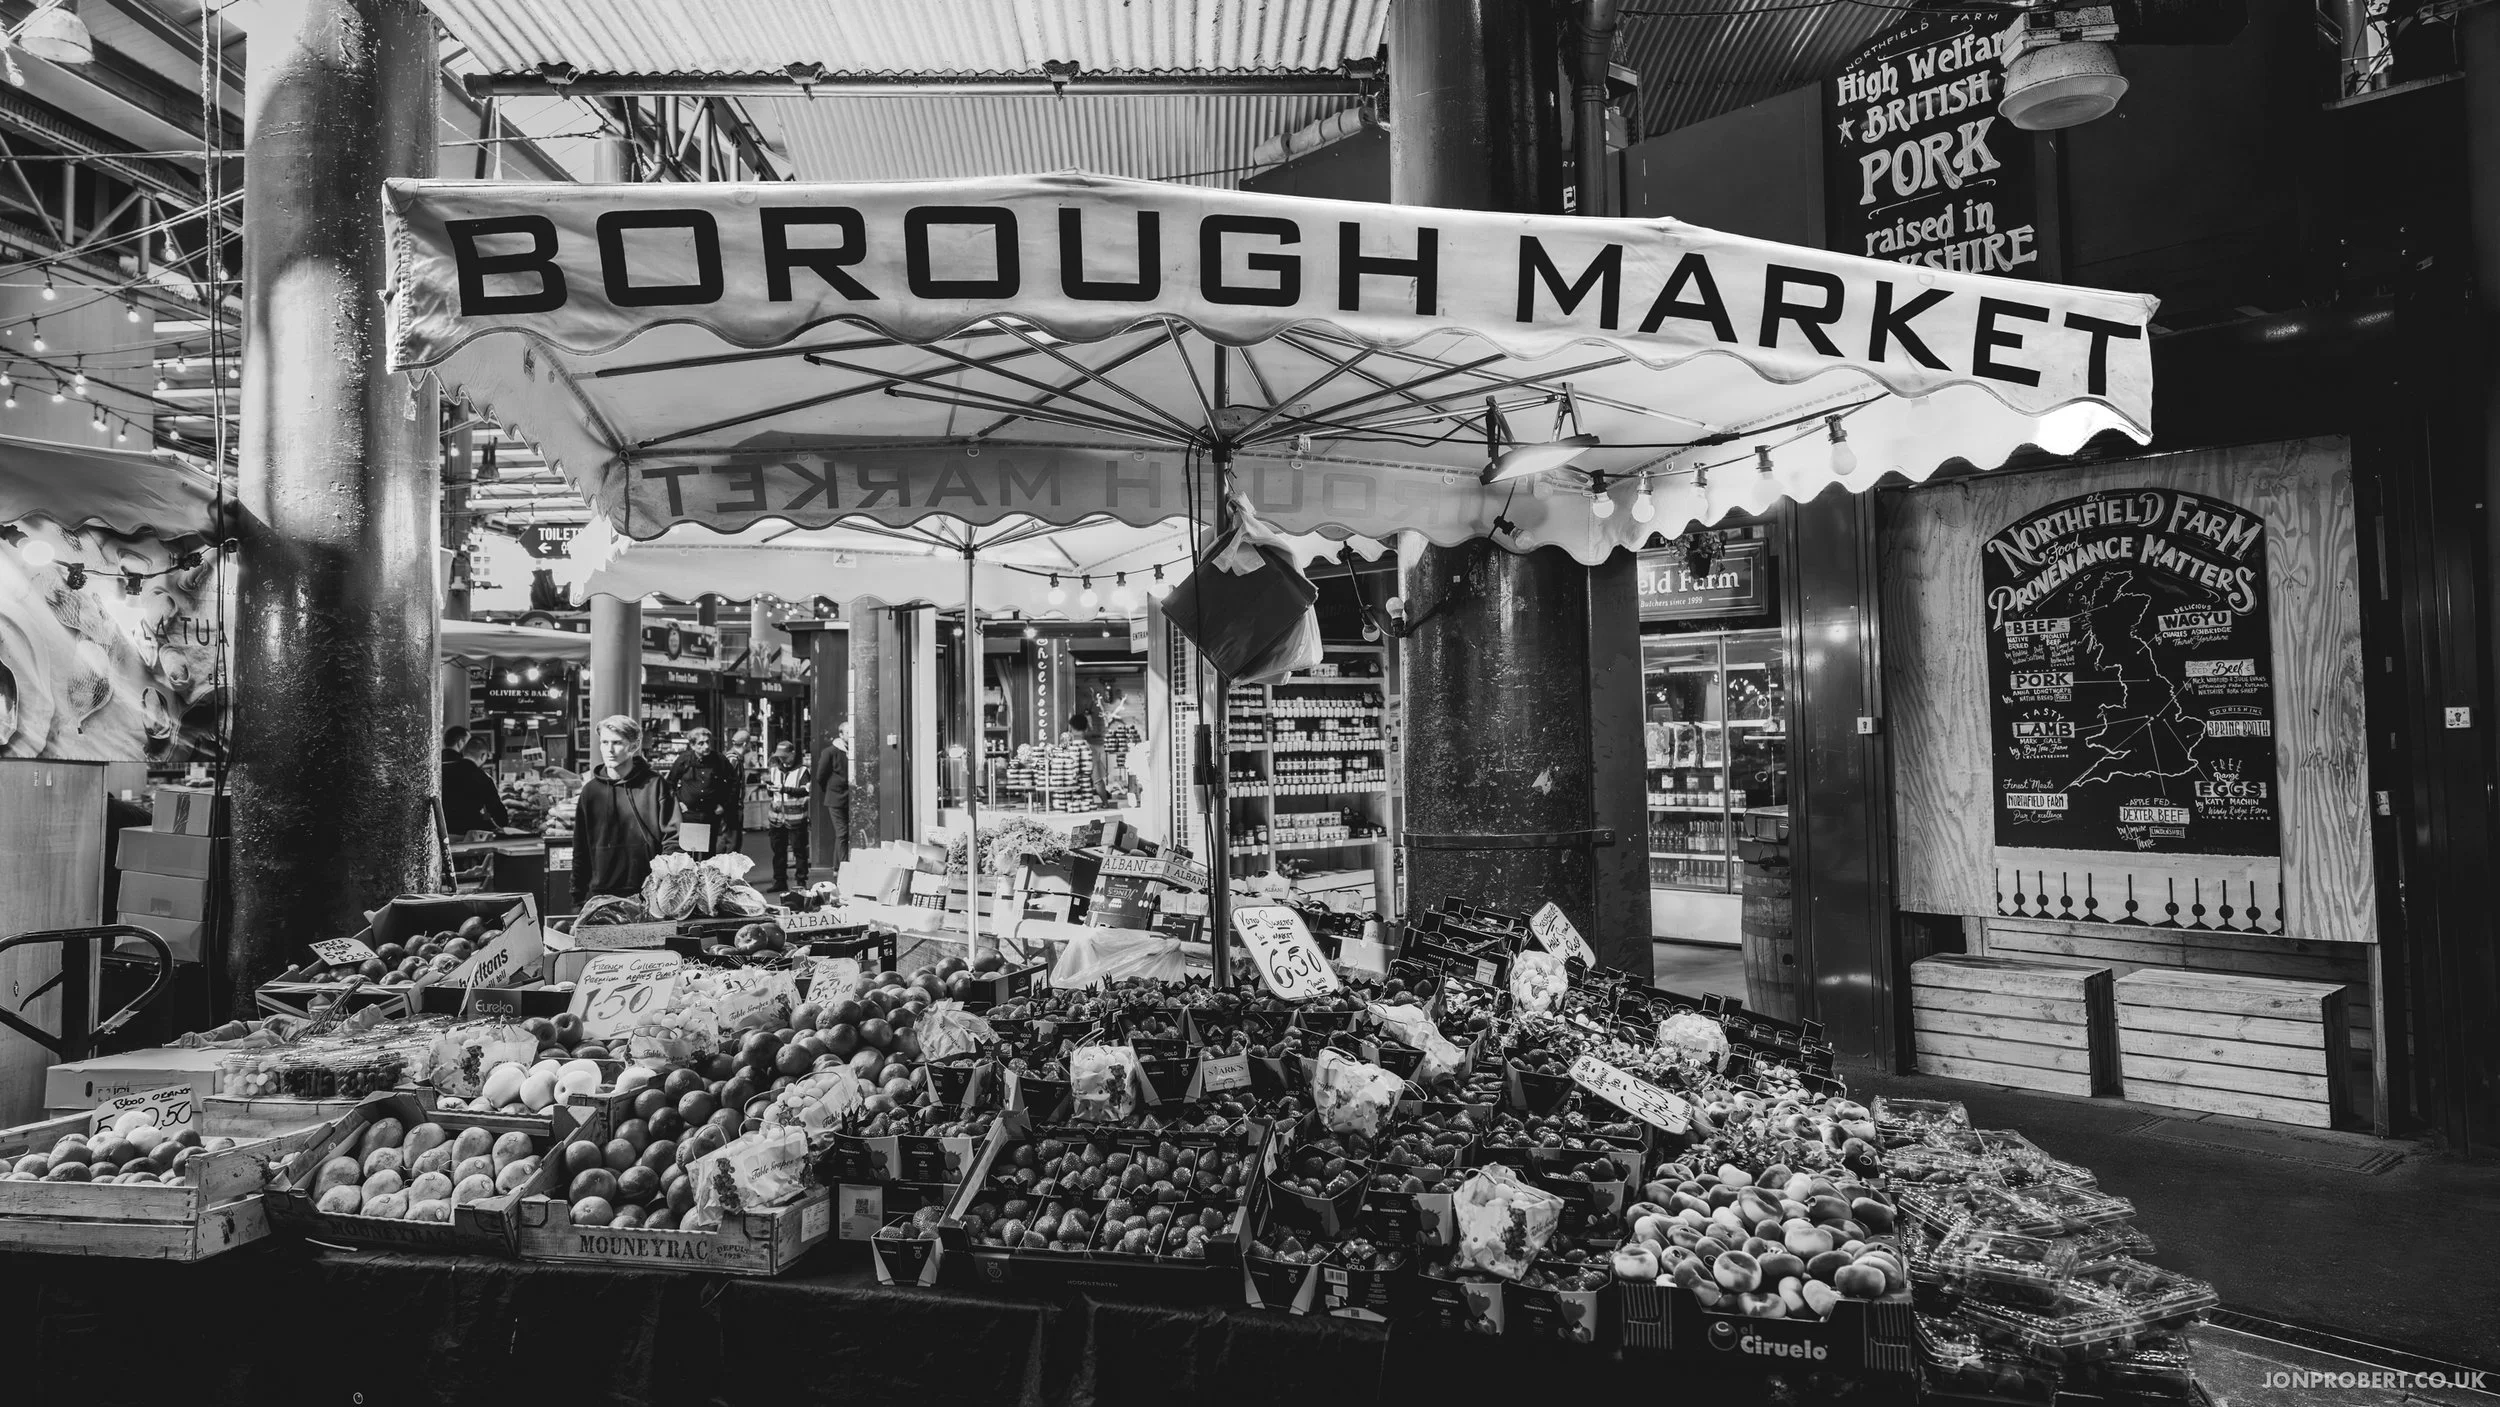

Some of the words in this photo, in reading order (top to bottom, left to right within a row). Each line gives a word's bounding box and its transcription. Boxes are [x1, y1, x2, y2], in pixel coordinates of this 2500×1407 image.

[1846, 22, 1929, 72] NORTHFIELD
[1950, 13, 1998, 23] FARM
[1837, 62, 1898, 106] High
[1907, 31, 2004, 83] Welfar
[1862, 70, 1992, 143] BRITISH
[1859, 116, 2000, 205] PORK
[1866, 203, 1955, 257] raised
[1963, 199, 1996, 234] in
[445, 206, 1438, 316] BOROUGH
[1516, 235, 2141, 396] MARKET
[538, 527, 582, 541] TOILET
[1987, 492, 2165, 578] NORTHFIELD
[2166, 494, 2262, 561] FARM
[2047, 534, 2082, 564] Food
[1678, 569, 1740, 592] Farm
[1988, 536, 2133, 631] PROVENANCE
[2140, 534, 2257, 616] MATTERS
[1640, 598, 1668, 608] Butchers
[1688, 596, 1703, 605] 1999
[2174, 603, 2211, 614] DELICIOUS
[2013, 619, 2058, 634] BEEF
[2163, 612, 2228, 629] WAGYU
[2191, 626, 2232, 636] ASHBRIDGE
[2212, 660, 2244, 676] Beef
[2016, 672, 2070, 688] PORK
[489, 689, 530, 697] OLIVIER'S
[531, 689, 563, 698] BAKY
[2023, 708, 2064, 721] TASTY
[2017, 722, 2073, 737] LAMB
[2208, 721, 2240, 736] SPRING
[2009, 746, 2020, 760] by
[2211, 758, 2243, 772] FREE
[2003, 778, 2029, 789] Finest
[2213, 772, 2240, 782] Range
[2199, 781, 2262, 797] EGGS
[2205, 798, 2225, 806] KATY
[2123, 808, 2155, 821] DEXTER
[2157, 808, 2184, 822] BEEF
[1102, 858, 1148, 873] ALBANI
[591, 959, 625, 972] FRENCH
[475, 1000, 514, 1014] Eureka
[579, 1235, 709, 1260] MOUNEYRAC
[1346, 1263, 1366, 1272] GOLD
[1740, 1324, 1754, 1335] el
[1740, 1335, 1828, 1360] Ciruelo
